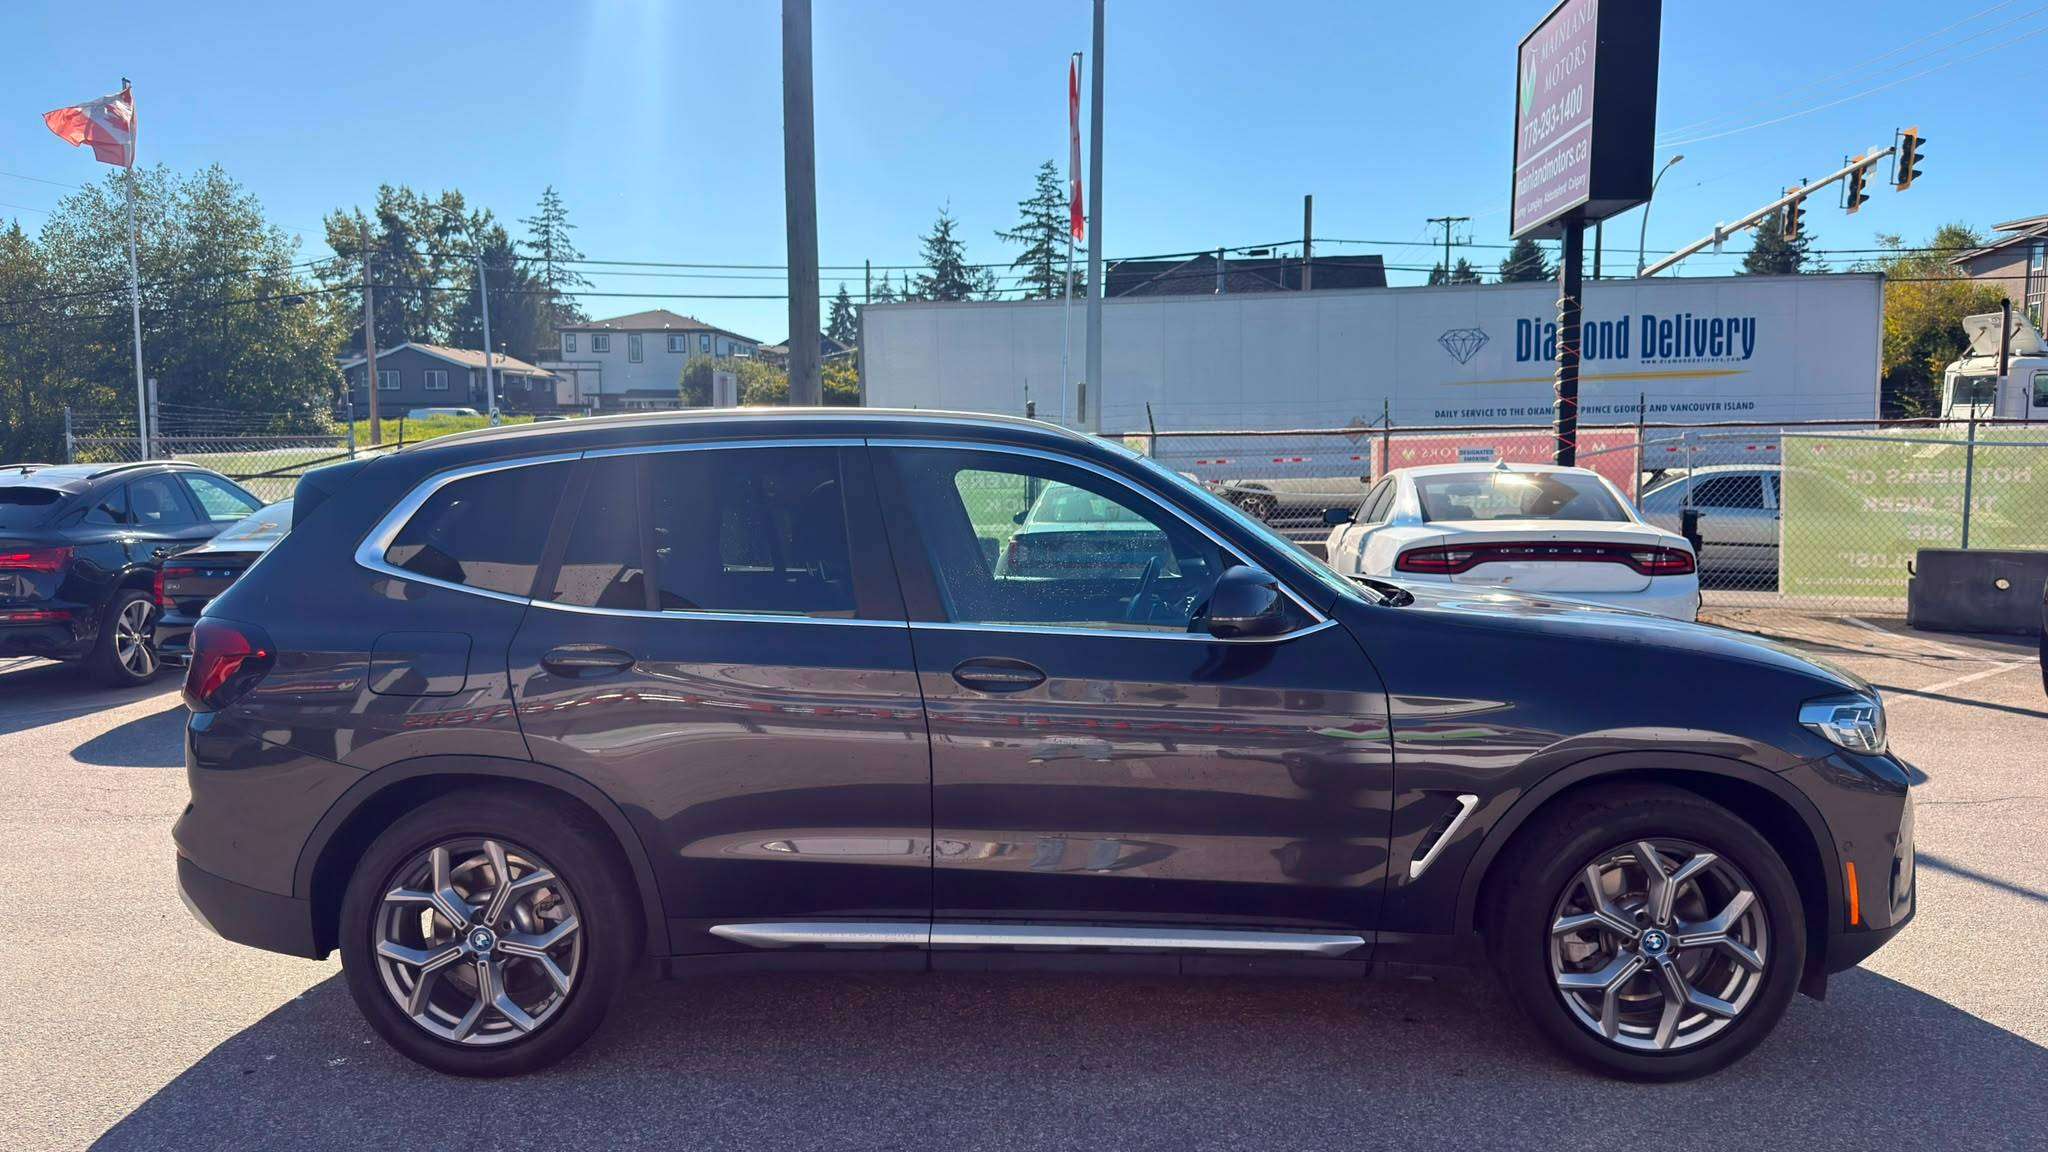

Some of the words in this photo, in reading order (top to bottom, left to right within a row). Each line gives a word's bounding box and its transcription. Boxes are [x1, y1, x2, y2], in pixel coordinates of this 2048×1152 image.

[1541, 0, 1596, 64] MAINLAND
[1544, 40, 1587, 96] MOTORS
[1523, 84, 1583, 152] 778-293-1400
[1517, 138, 1587, 196] mainlandmotors.ca
[1516, 315, 1630, 362] Diaond
[1641, 313, 1756, 361] Delivery
[1434, 409, 1458, 418] DAILY
[1460, 408, 1494, 417] SERVICE
[1496, 407, 1507, 416] TO
[1510, 407, 1525, 416] THE
[1580, 404, 1611, 414] PRINCE
[1650, 403, 1668, 412] AND
[1669, 402, 1722, 412] VANCOUVER
[1724, 401, 1754, 411] ISLAND
